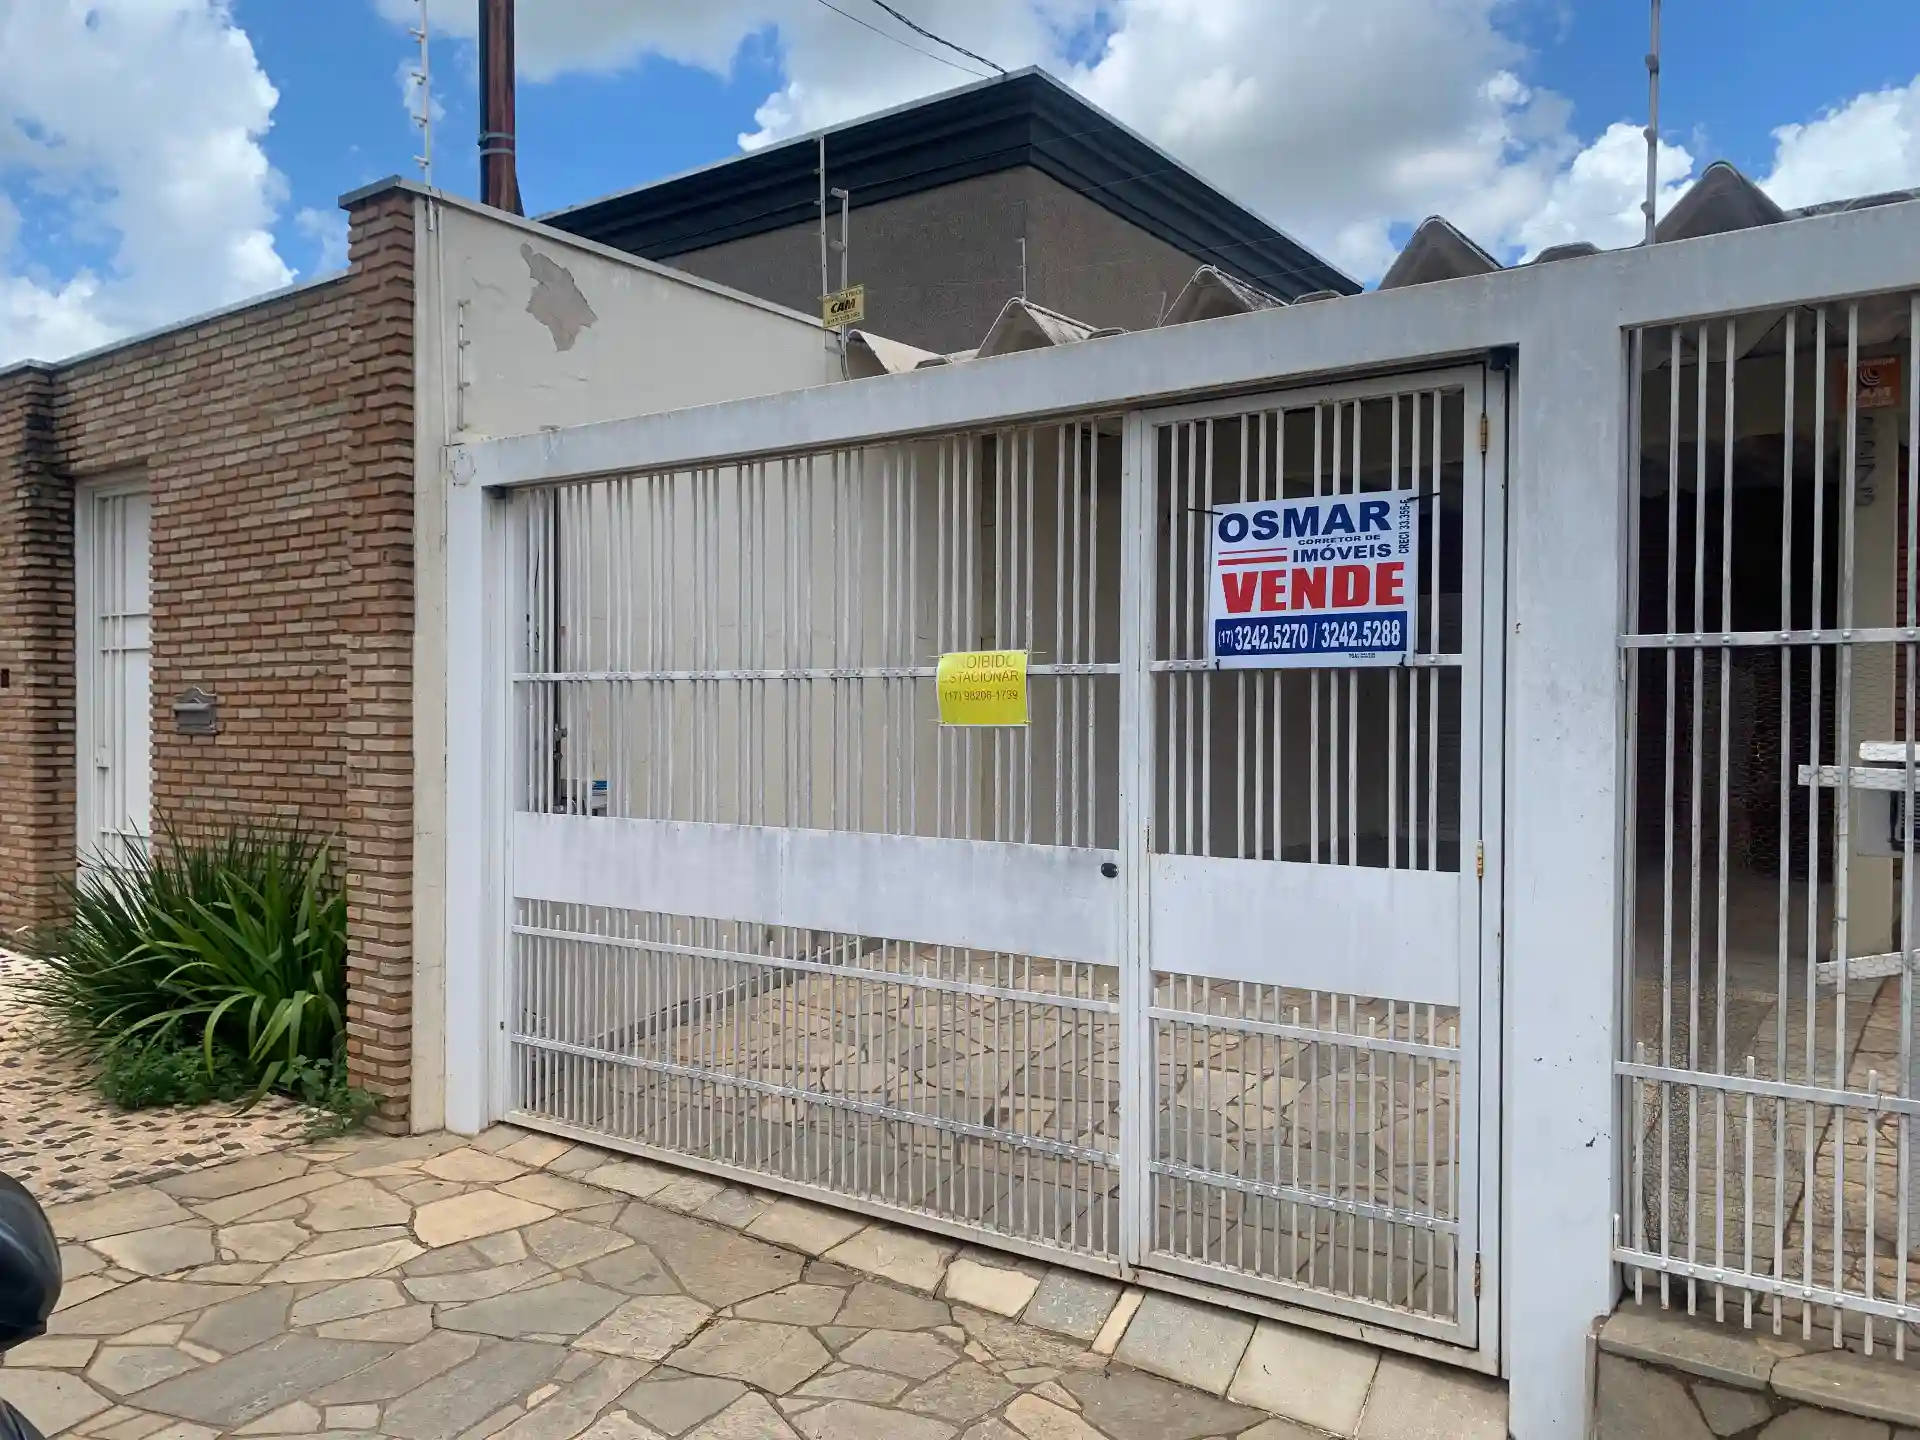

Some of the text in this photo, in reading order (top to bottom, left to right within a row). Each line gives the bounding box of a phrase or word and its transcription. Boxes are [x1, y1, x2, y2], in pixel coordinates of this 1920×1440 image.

[830, 298, 856, 314] CAM
[1218, 500, 1392, 544] OSMAR
[1298, 533, 1381, 546] CORRETOR DE
[1398, 531, 1410, 554] CRECI
[1293, 543, 1392, 563] IMÓVEIS
[1221, 561, 1405, 614] VENDE
[1234, 623, 1309, 651] 3242.5270
[1320, 619, 1402, 649] 3242.5288
[940, 670, 1019, 684] ESTACIONAR
